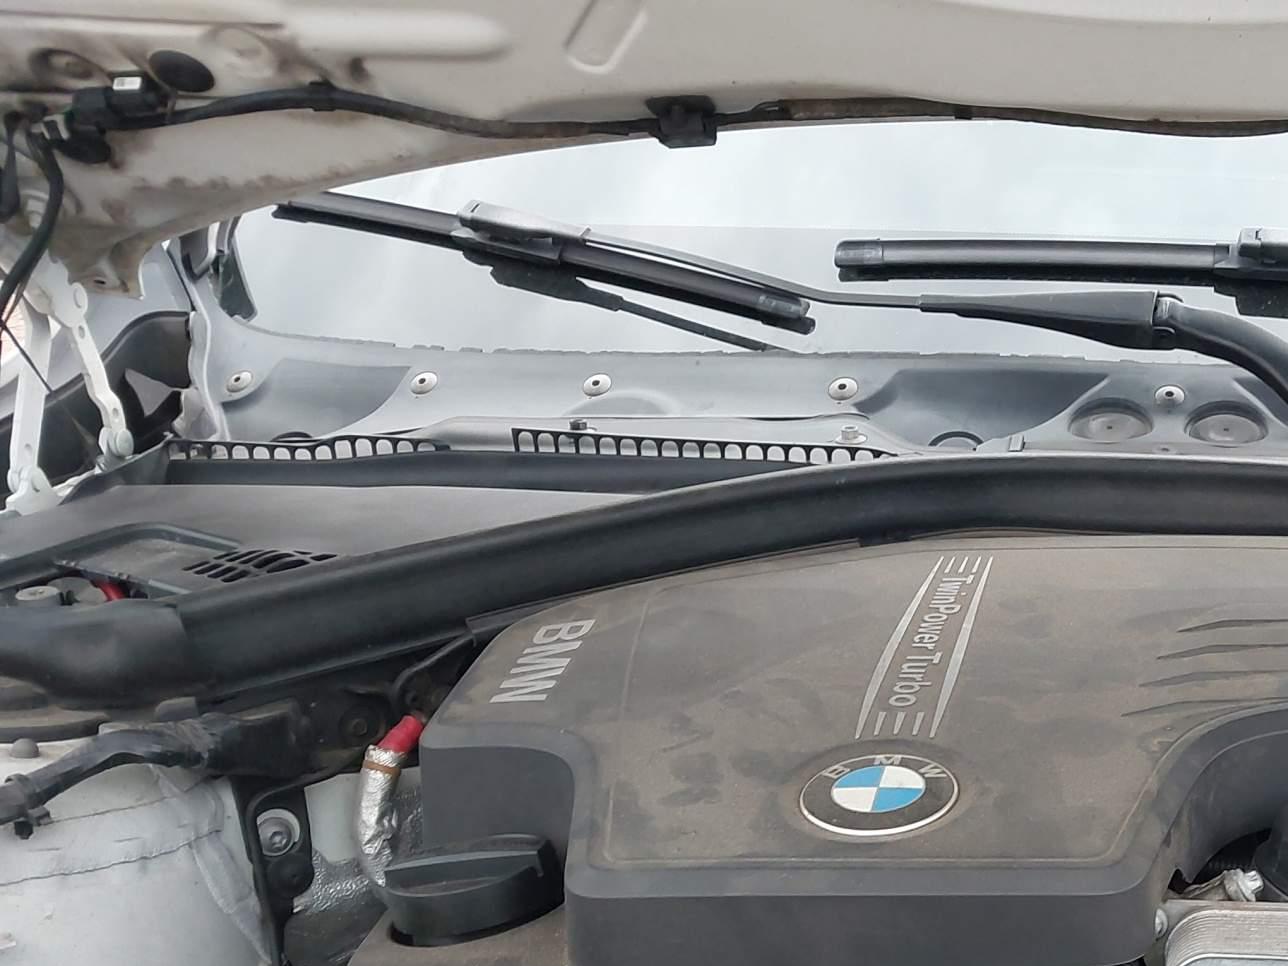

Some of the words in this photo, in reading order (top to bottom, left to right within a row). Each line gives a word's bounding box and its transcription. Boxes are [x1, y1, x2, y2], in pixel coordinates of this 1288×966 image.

[911, 574, 975, 650] TwinPower
[489, 619, 596, 703] BMW
[888, 651, 943, 707] Turbo
